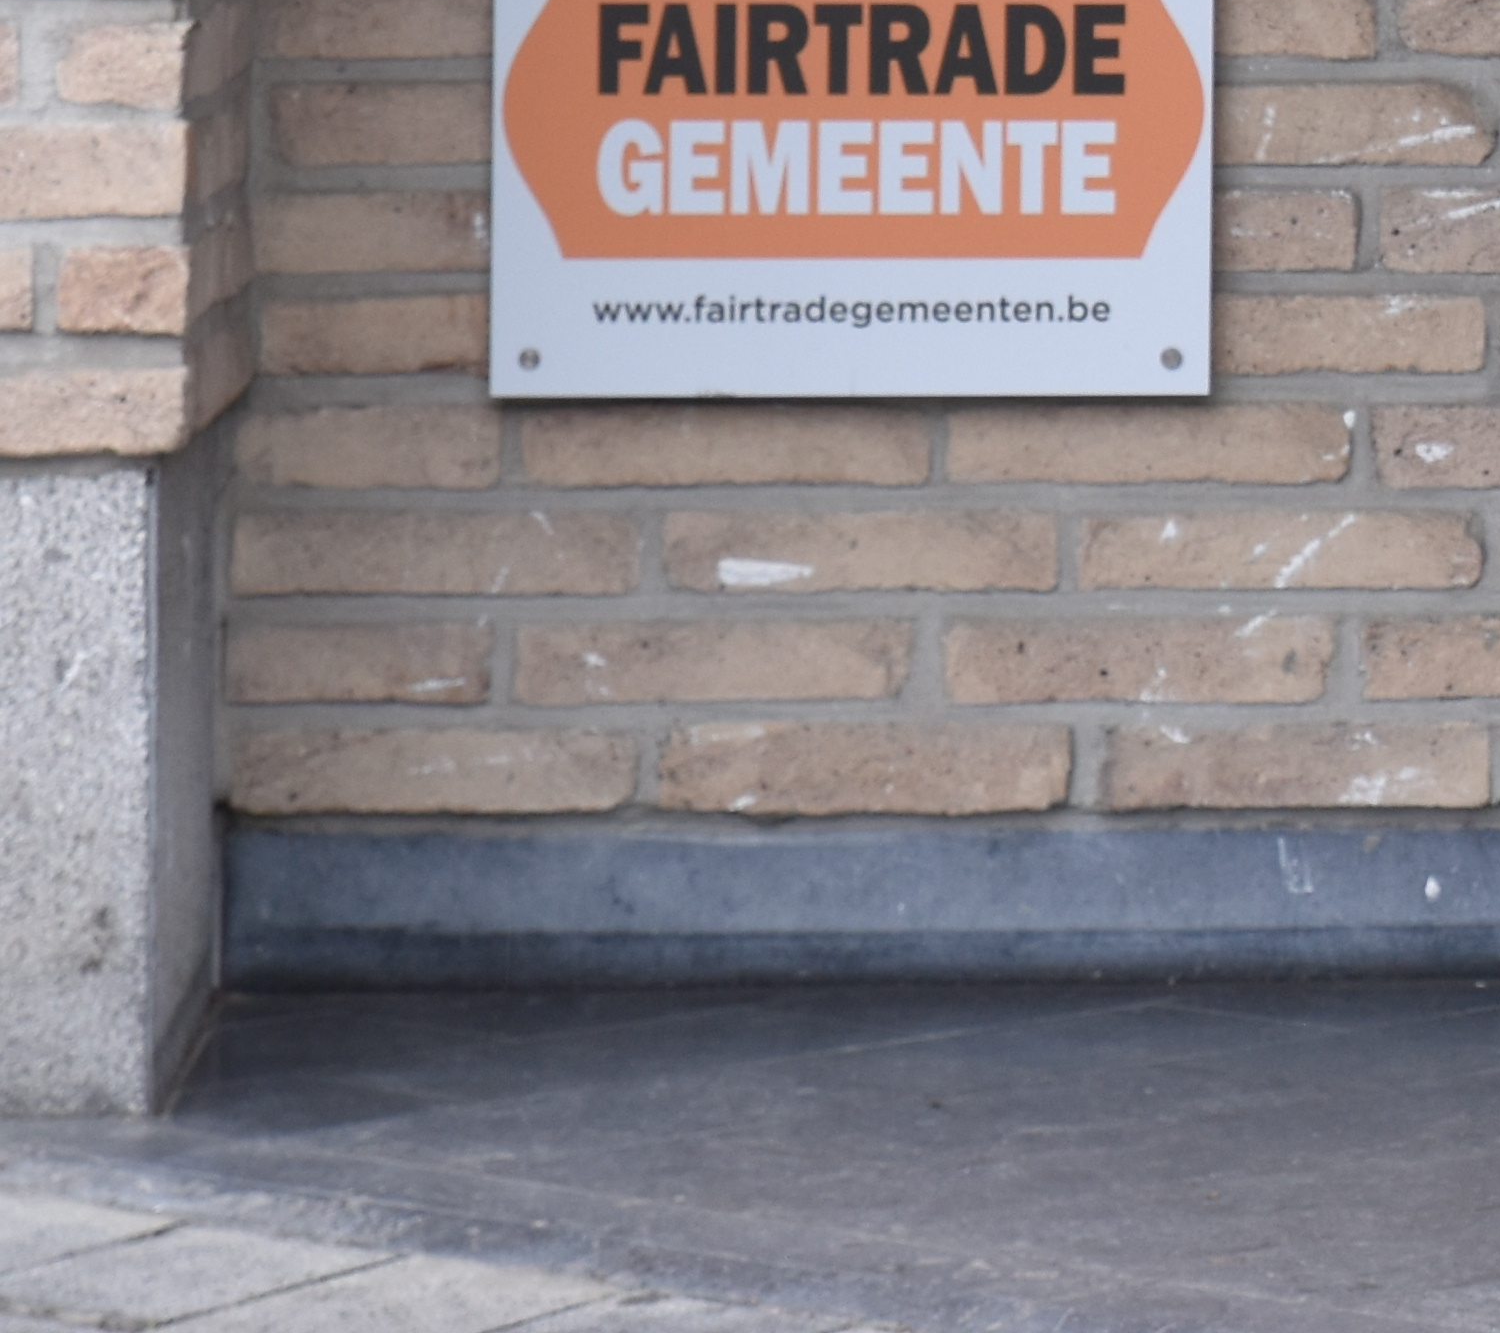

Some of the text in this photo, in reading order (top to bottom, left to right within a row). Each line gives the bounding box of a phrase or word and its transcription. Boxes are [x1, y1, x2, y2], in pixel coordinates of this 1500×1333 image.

[597, 2, 1127, 97] FAIRTRADE
[595, 117, 1118, 218] GEMEENTE
[591, 294, 1113, 329] www.fairtradegemeenten.be
